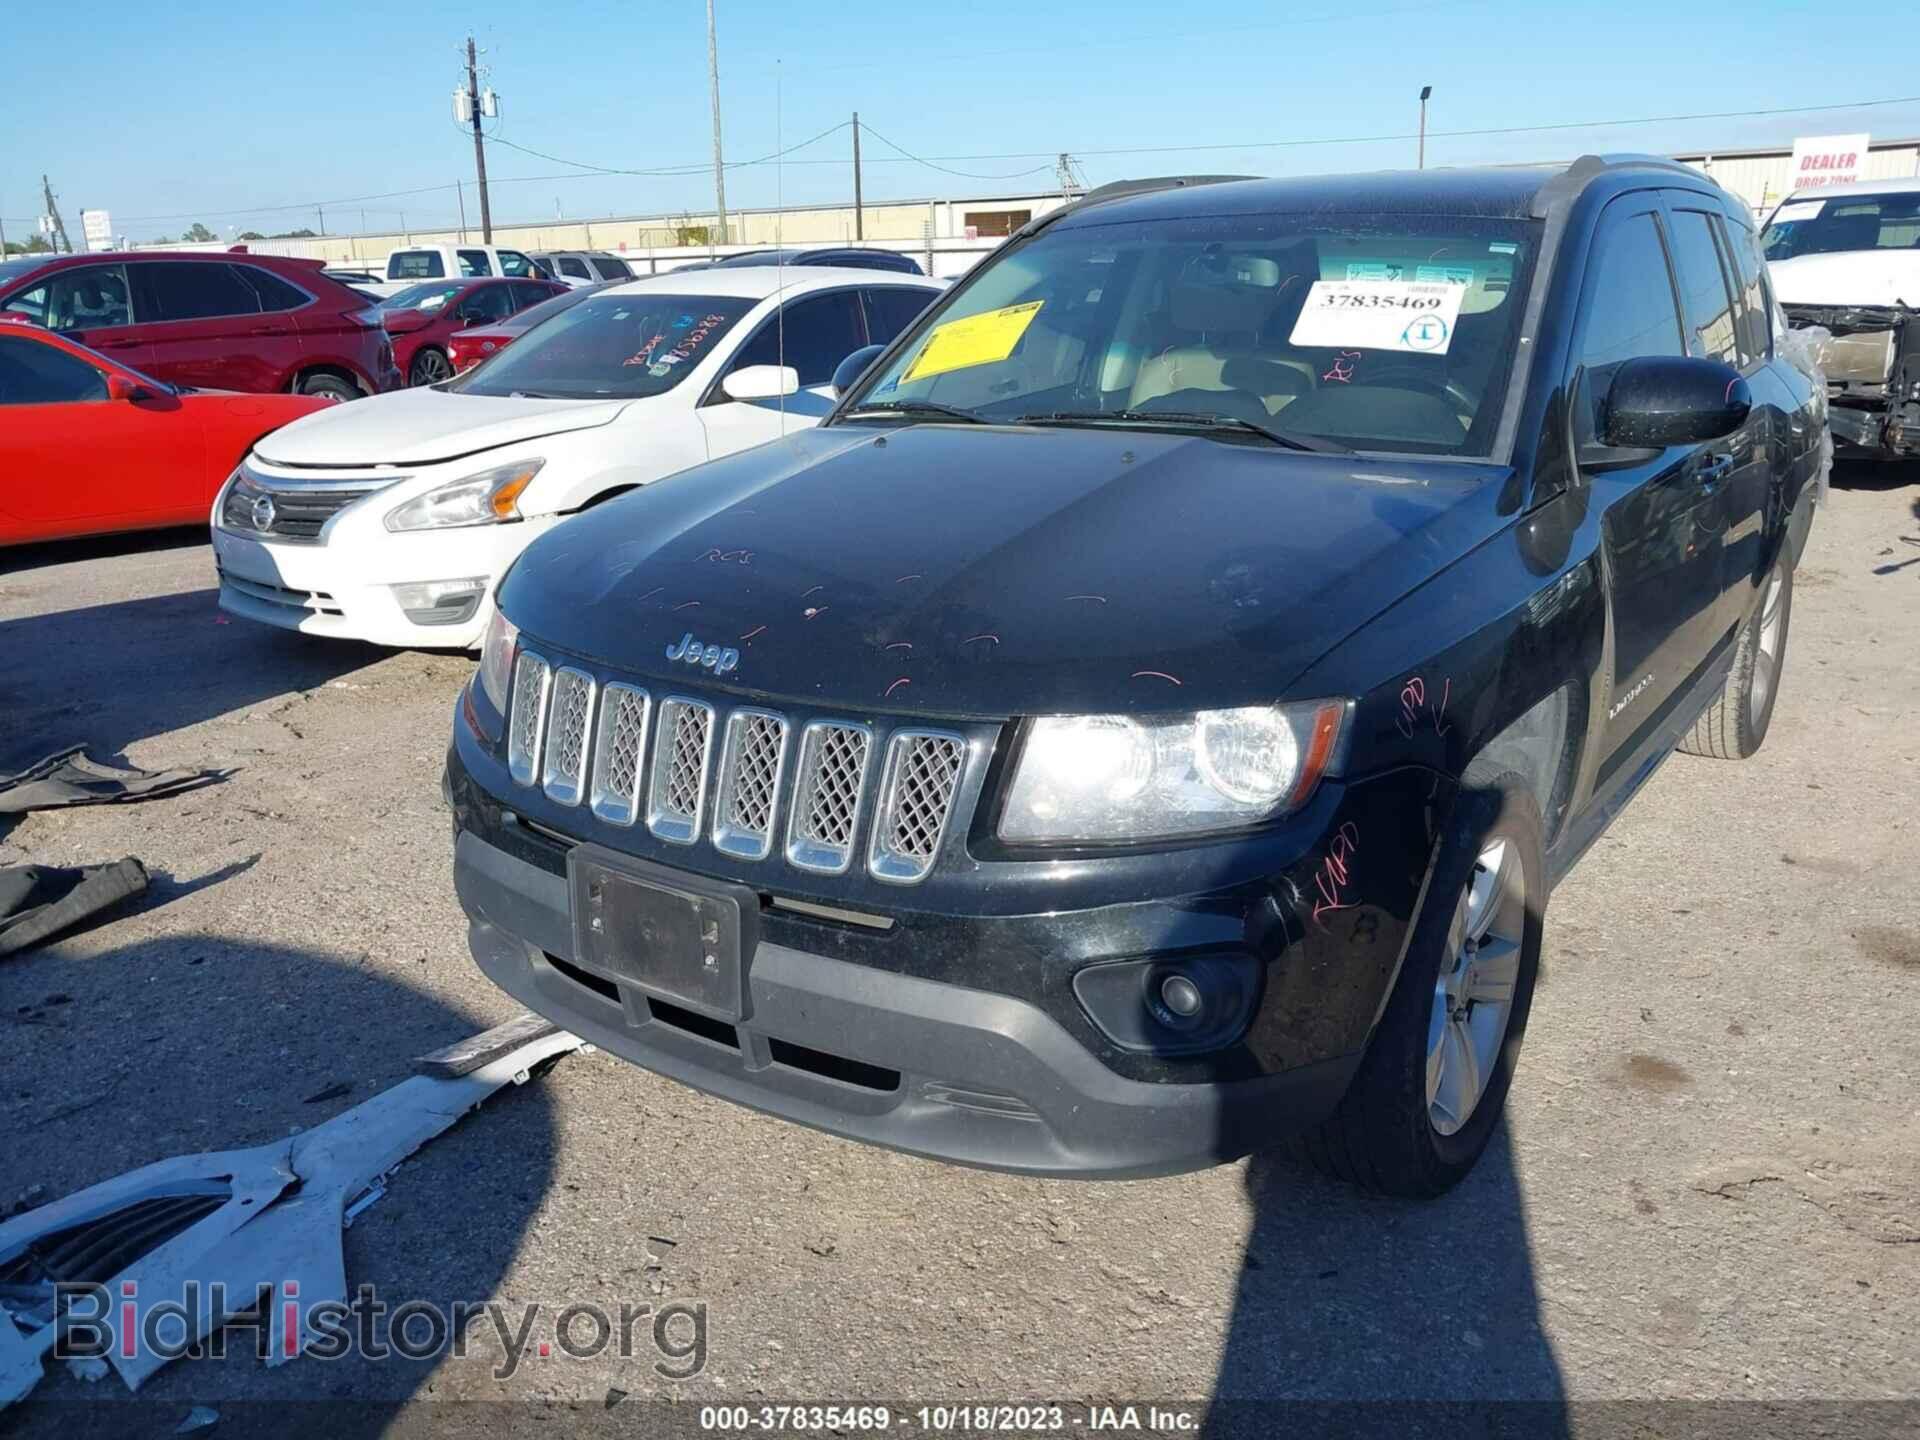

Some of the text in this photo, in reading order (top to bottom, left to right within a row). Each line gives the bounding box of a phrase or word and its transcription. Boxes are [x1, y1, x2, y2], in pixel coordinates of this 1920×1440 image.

[1800, 152, 1857, 170] DEALER
[1319, 294, 1442, 310] 37835469
[666, 632, 740, 675] Jeep
